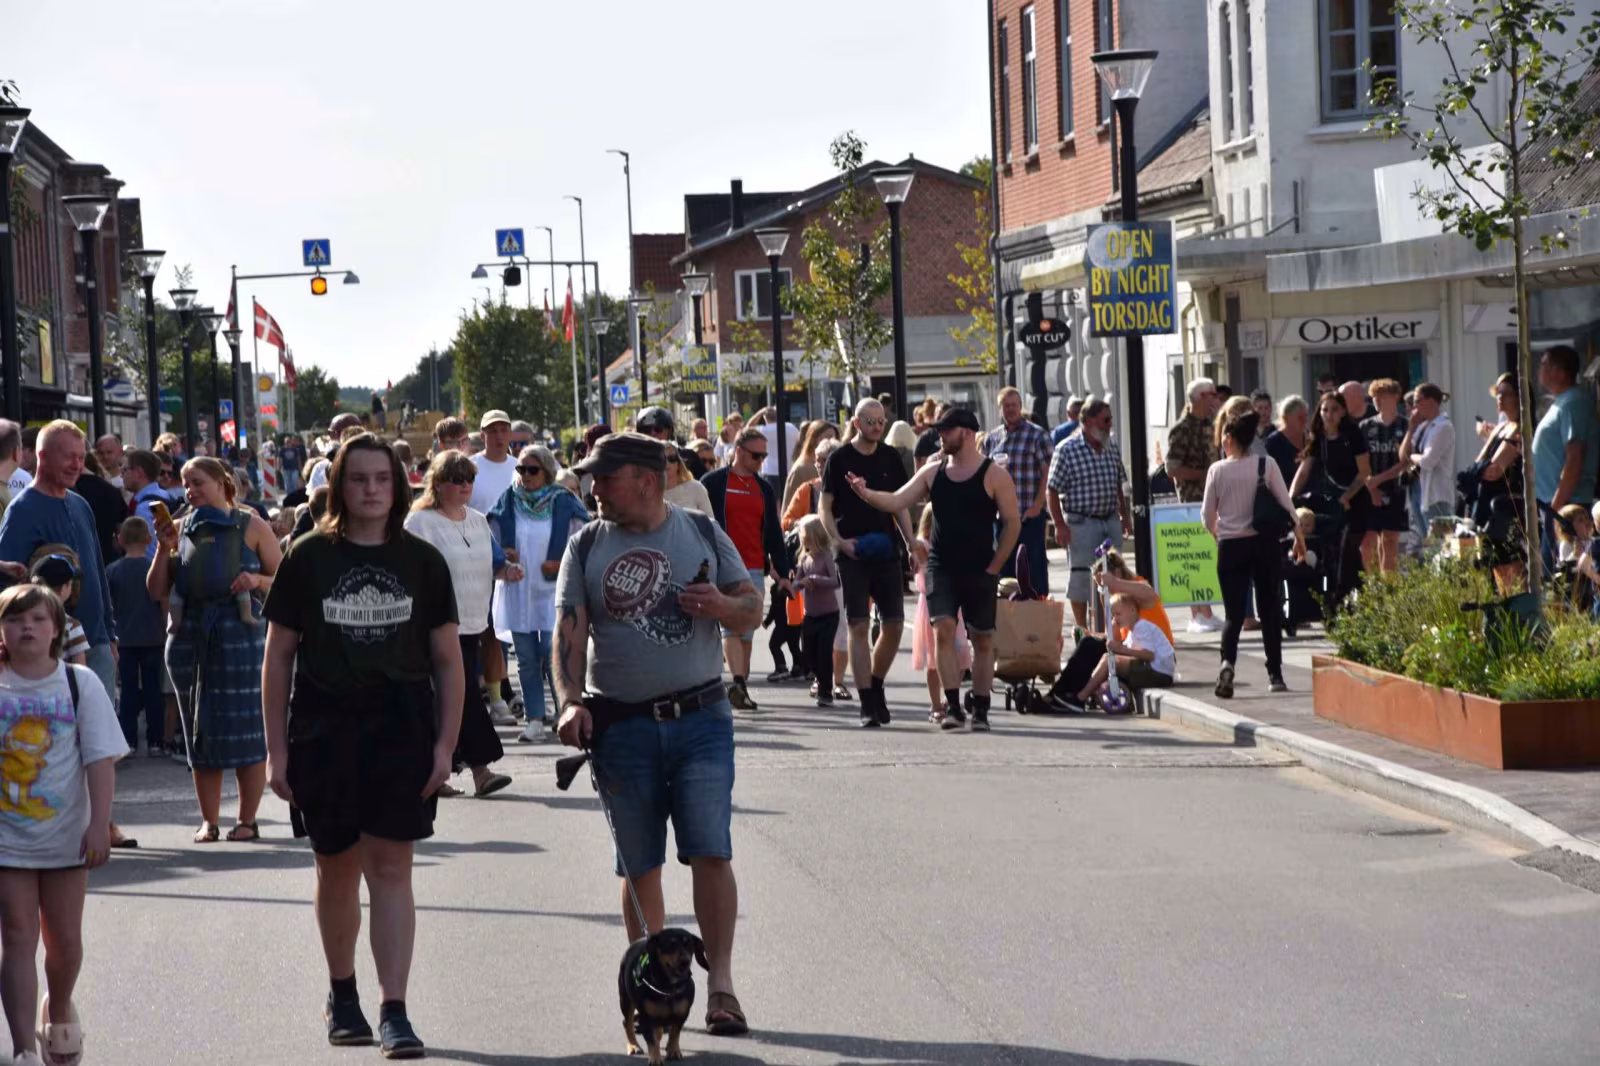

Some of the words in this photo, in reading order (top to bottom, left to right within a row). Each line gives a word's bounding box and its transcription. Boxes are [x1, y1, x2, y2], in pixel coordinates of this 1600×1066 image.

[1106, 229, 1153, 258] OPEN
[1091, 266, 1111, 296] BY
[1118, 264, 1170, 294] NIGHT
[1092, 300, 1171, 332] TORSDAG
[1025, 333, 1042, 344] KIT
[1044, 331, 1066, 344] CUT
[1298, 316, 1423, 345] Optiker
[614, 559, 650, 582] CLUB
[1170, 574, 1189, 590] KIG
[606, 572, 641, 596] SODA
[1191, 588, 1214, 602] IND
[339, 606, 370, 622] ULTIMATE
